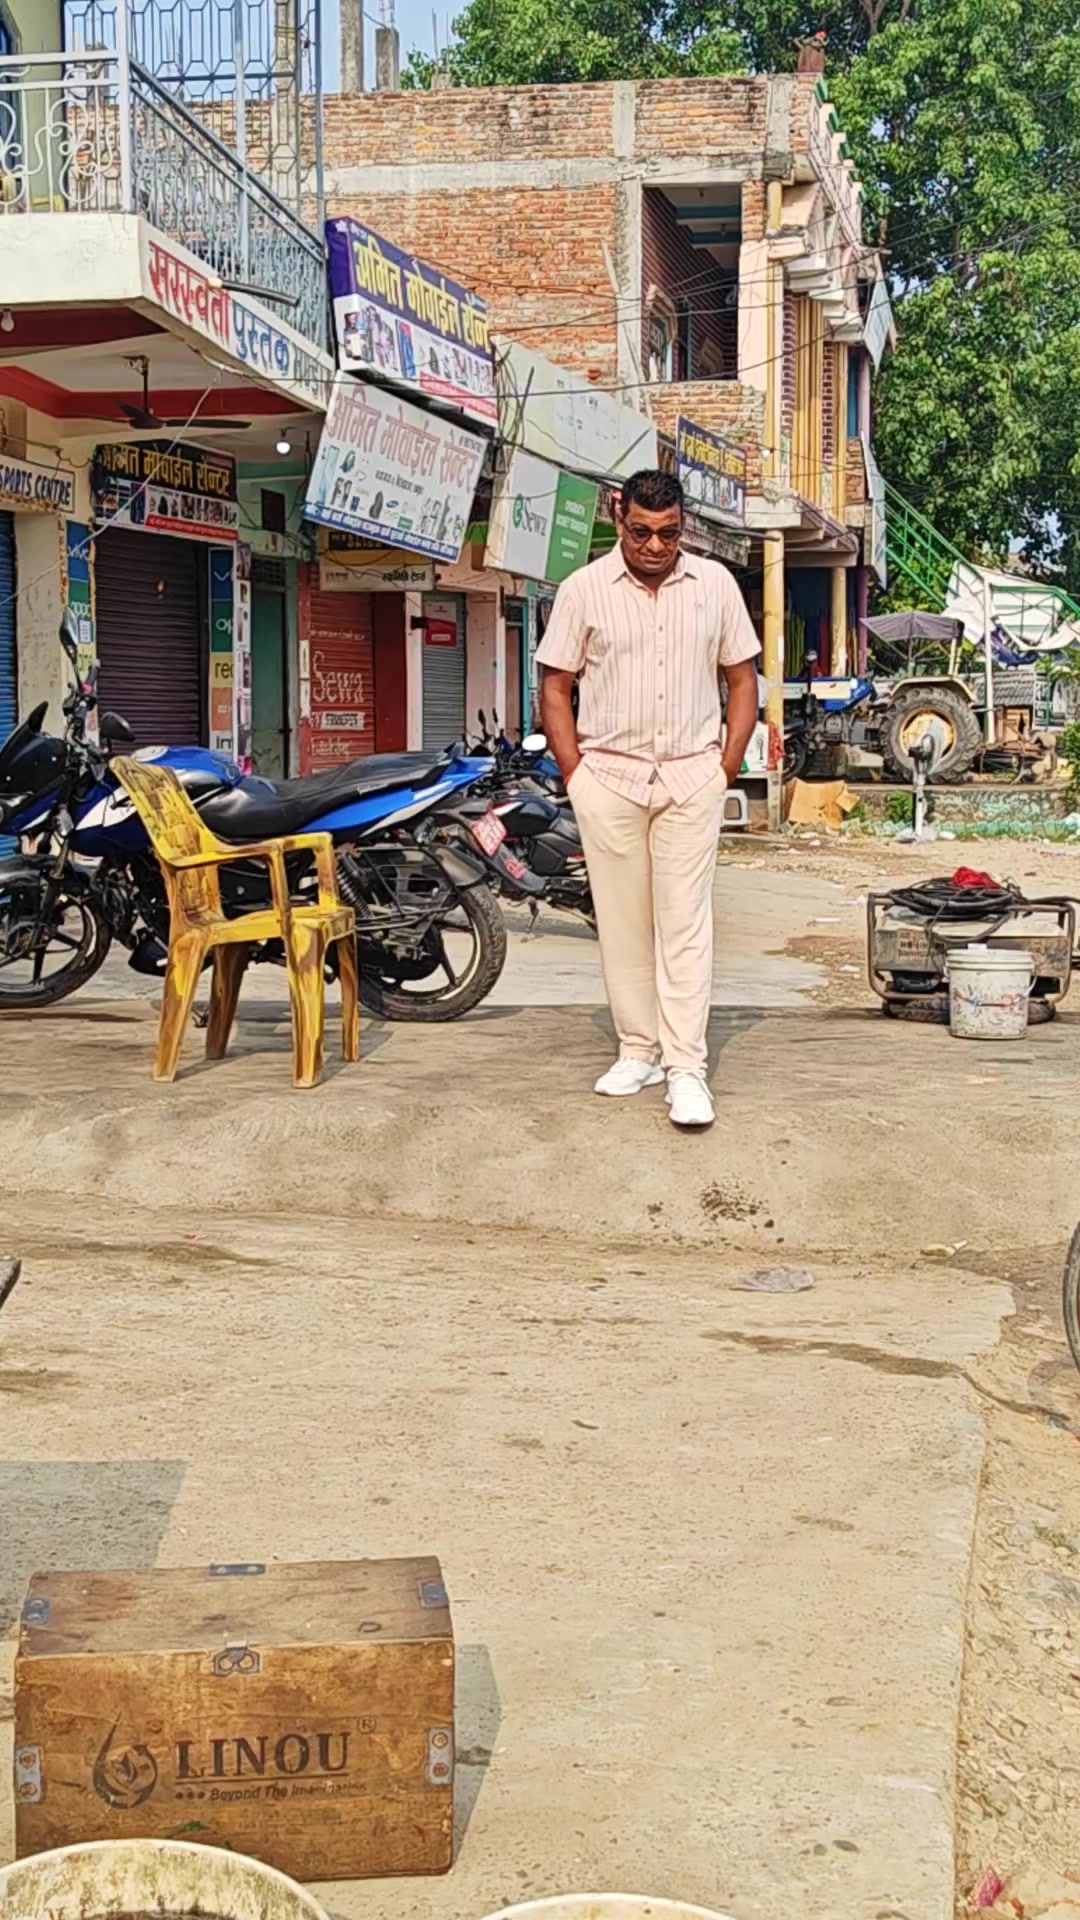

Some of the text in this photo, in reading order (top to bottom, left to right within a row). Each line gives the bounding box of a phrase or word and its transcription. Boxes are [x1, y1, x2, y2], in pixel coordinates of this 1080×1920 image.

[231, 298, 290, 376] पुस्तक
[34, 474, 71, 506] CENTRE
[175, 1731, 351, 1779] LINOU
[209, 1787, 261, 1802] Beyond
[264, 1783, 289, 1800] The
